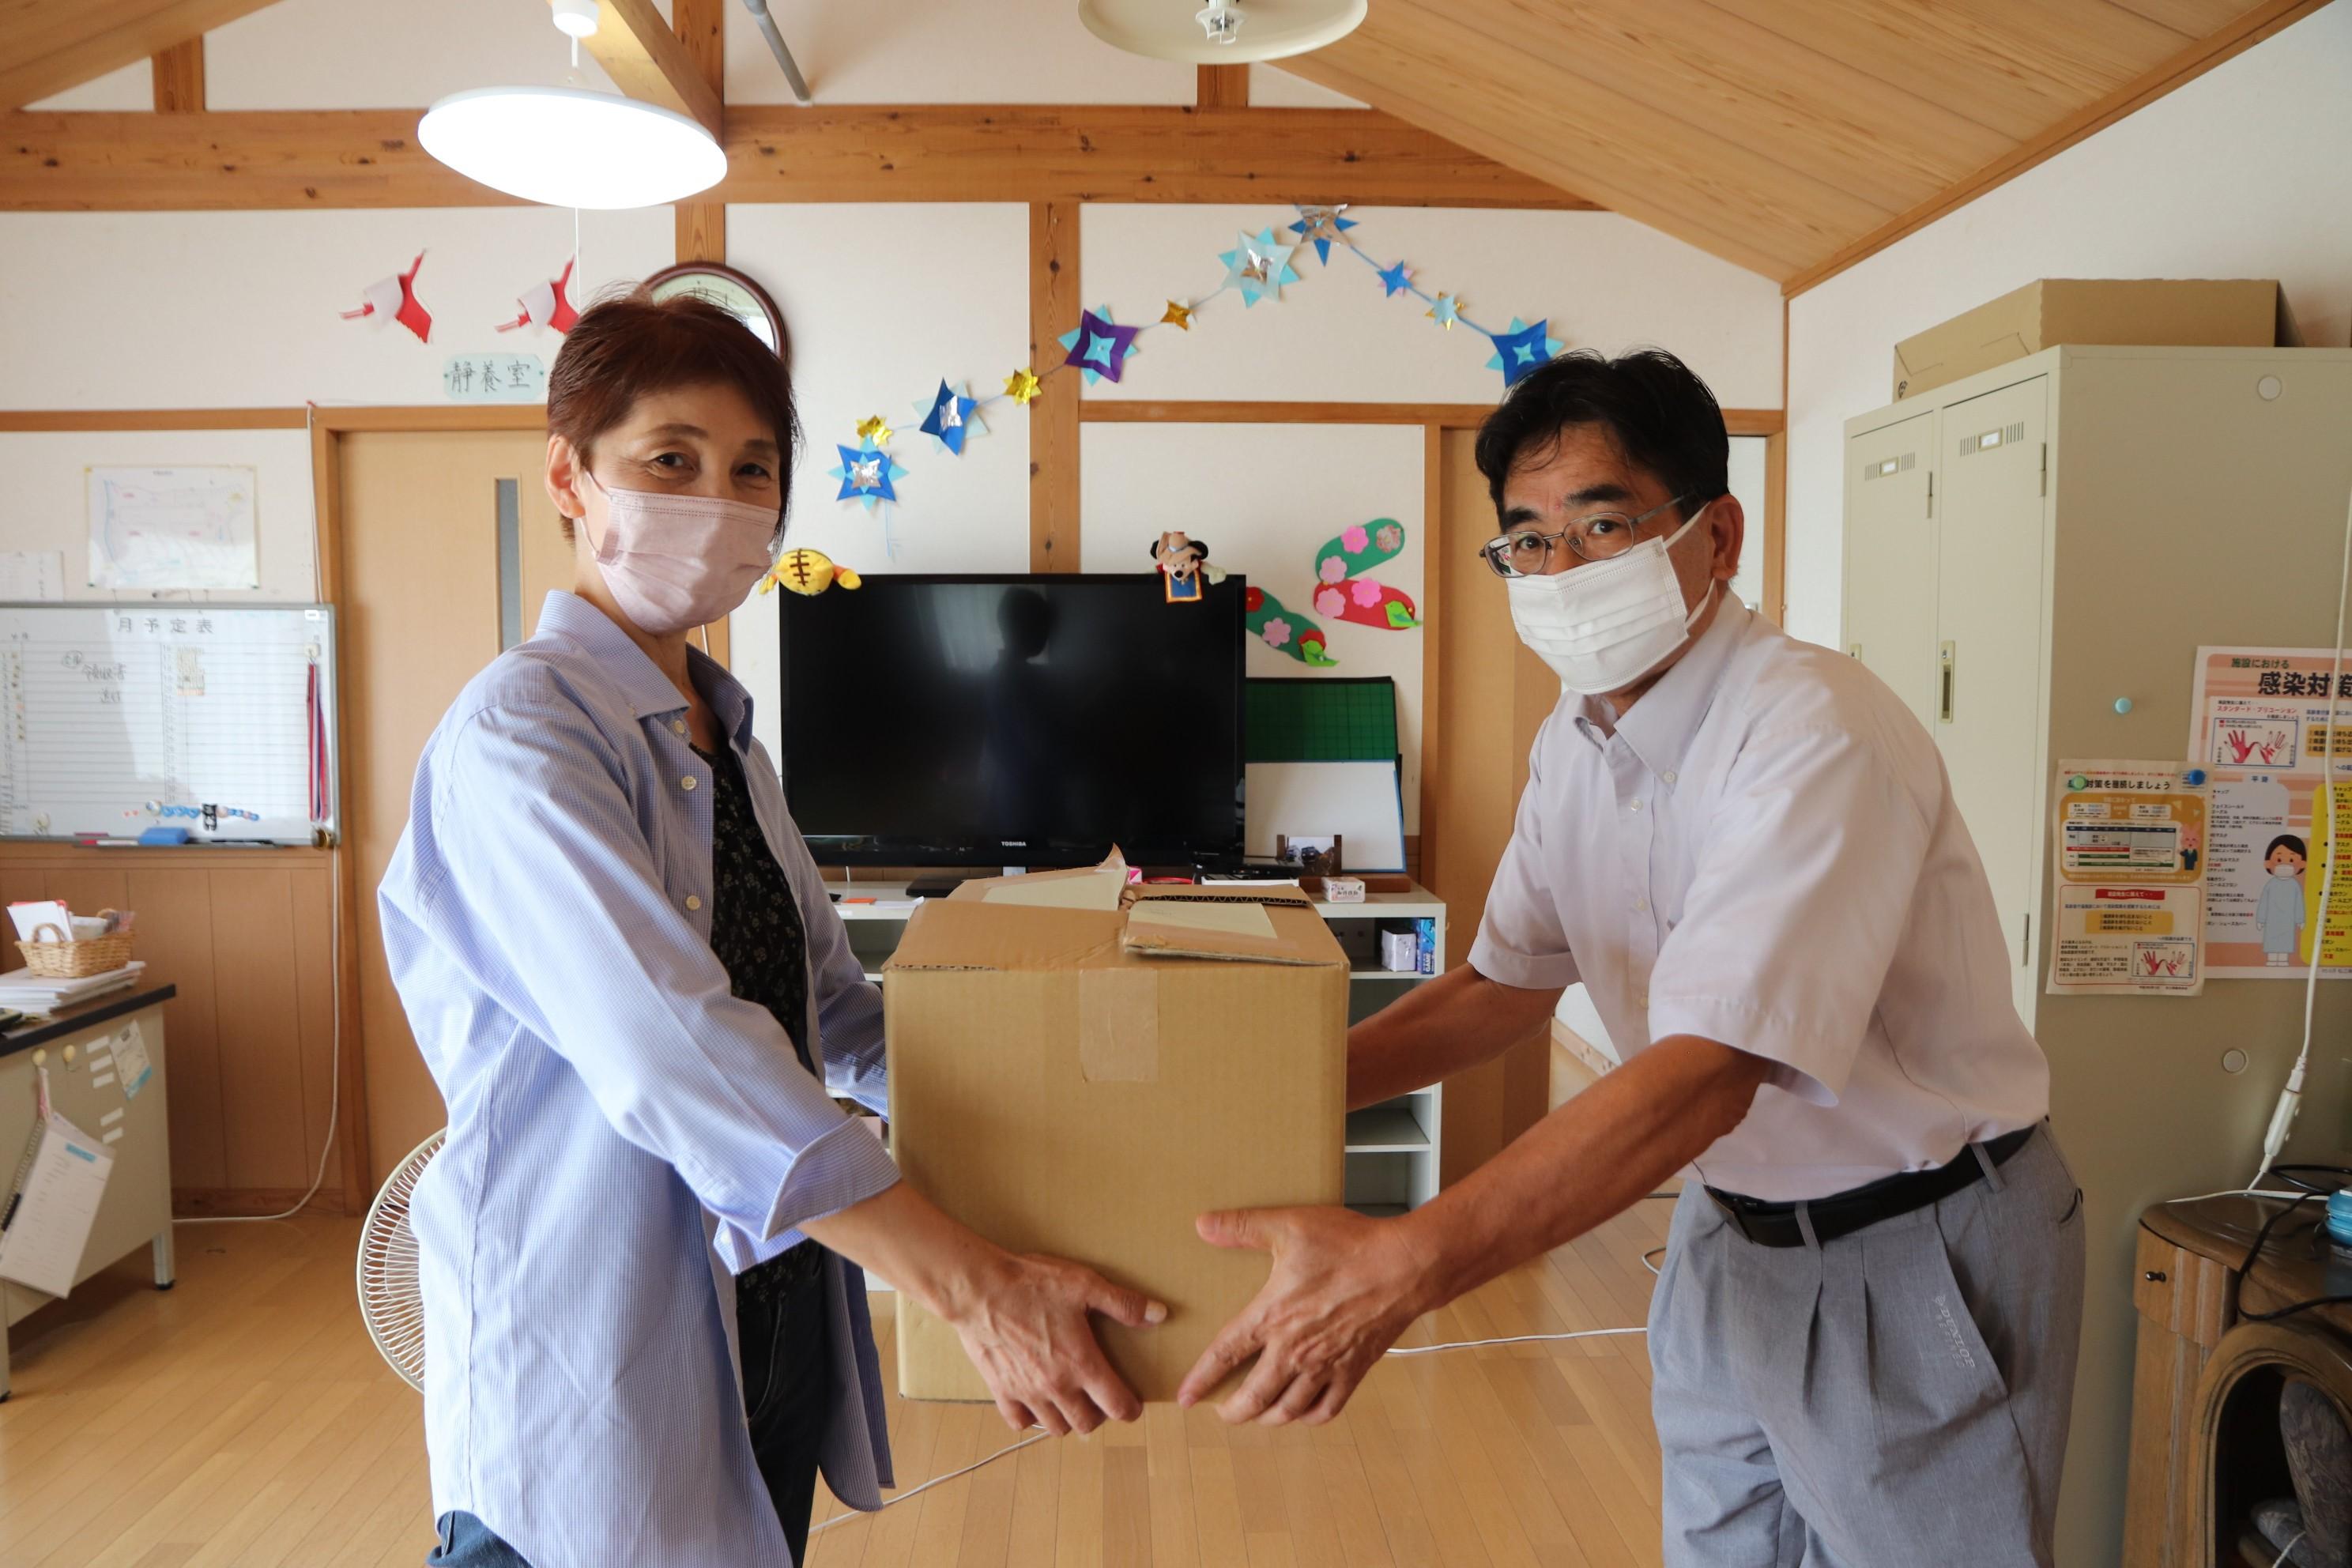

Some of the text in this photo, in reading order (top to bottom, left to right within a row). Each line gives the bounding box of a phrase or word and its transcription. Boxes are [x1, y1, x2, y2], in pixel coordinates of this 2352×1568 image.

[450, 360, 531, 393] 静養室
[119, 617, 213, 633] 月予定表
[2231, 658, 2290, 669] 施設における
